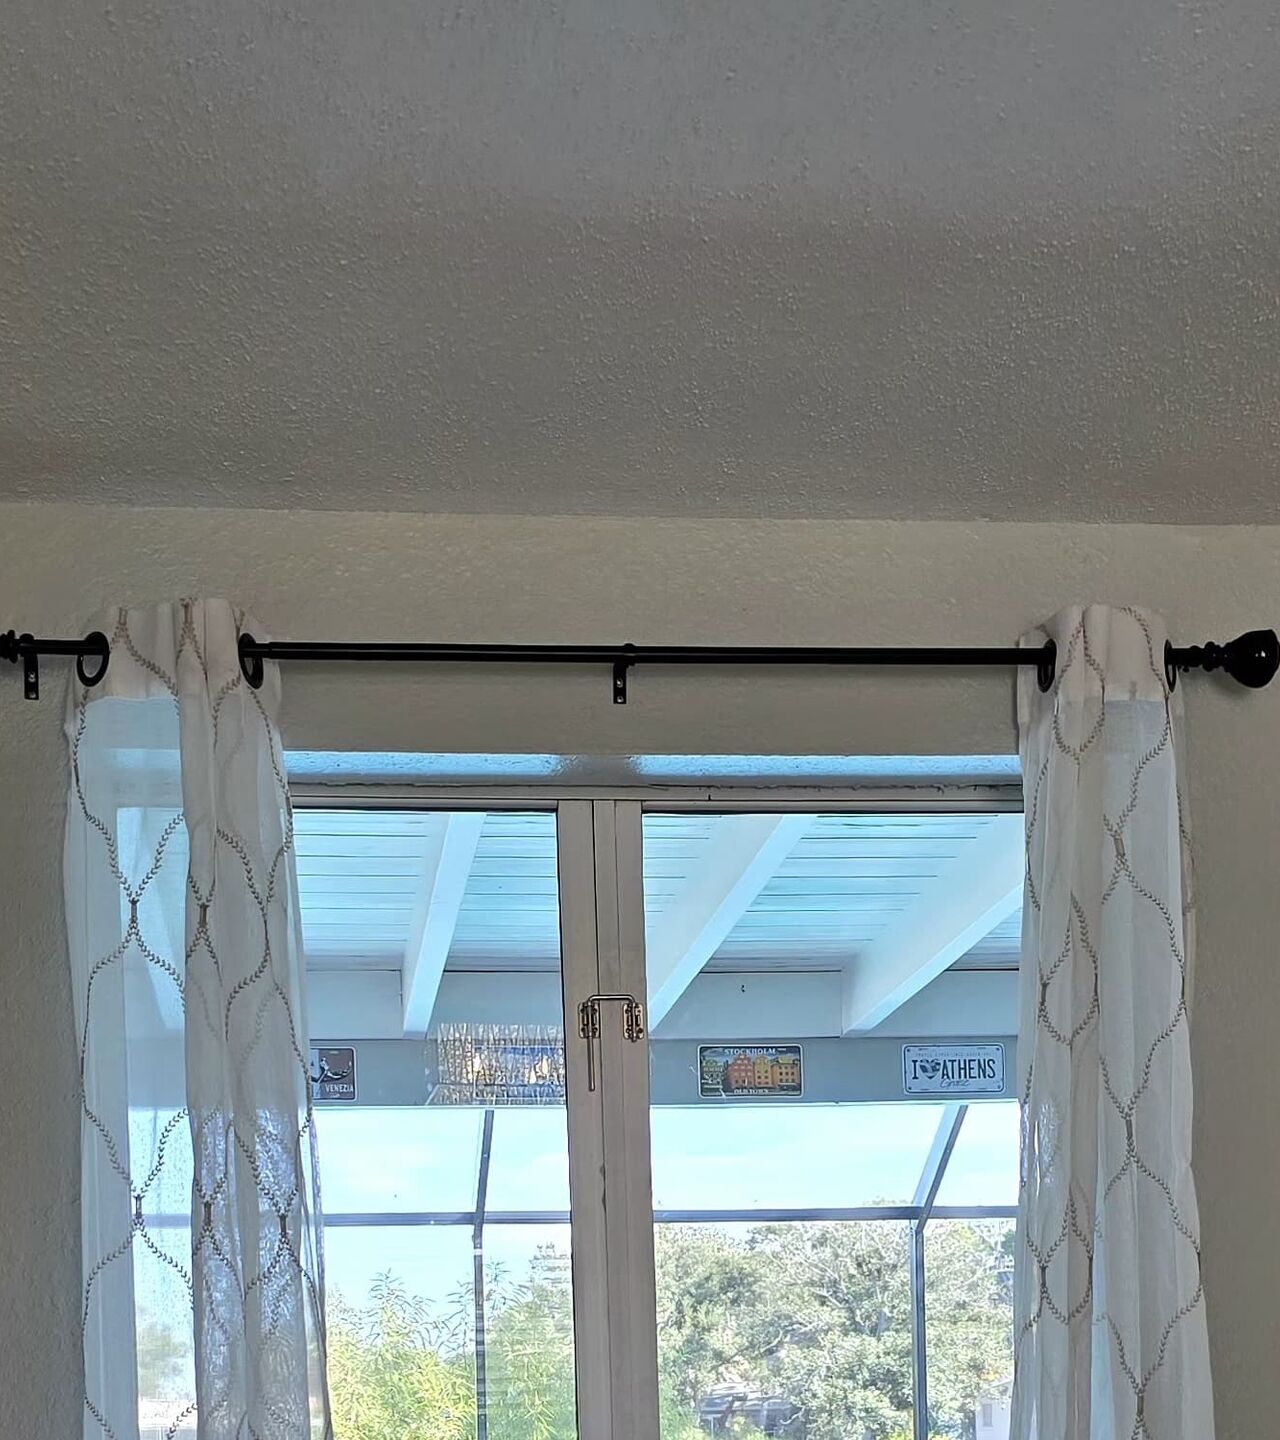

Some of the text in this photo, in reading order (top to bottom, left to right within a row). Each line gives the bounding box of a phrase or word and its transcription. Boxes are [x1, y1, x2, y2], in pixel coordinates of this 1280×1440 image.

[724, 1047, 776, 1055] STOCKHOLM
[911, 1058, 996, 1080] I ATHENS
[324, 1083, 354, 1093] VENEZIA
